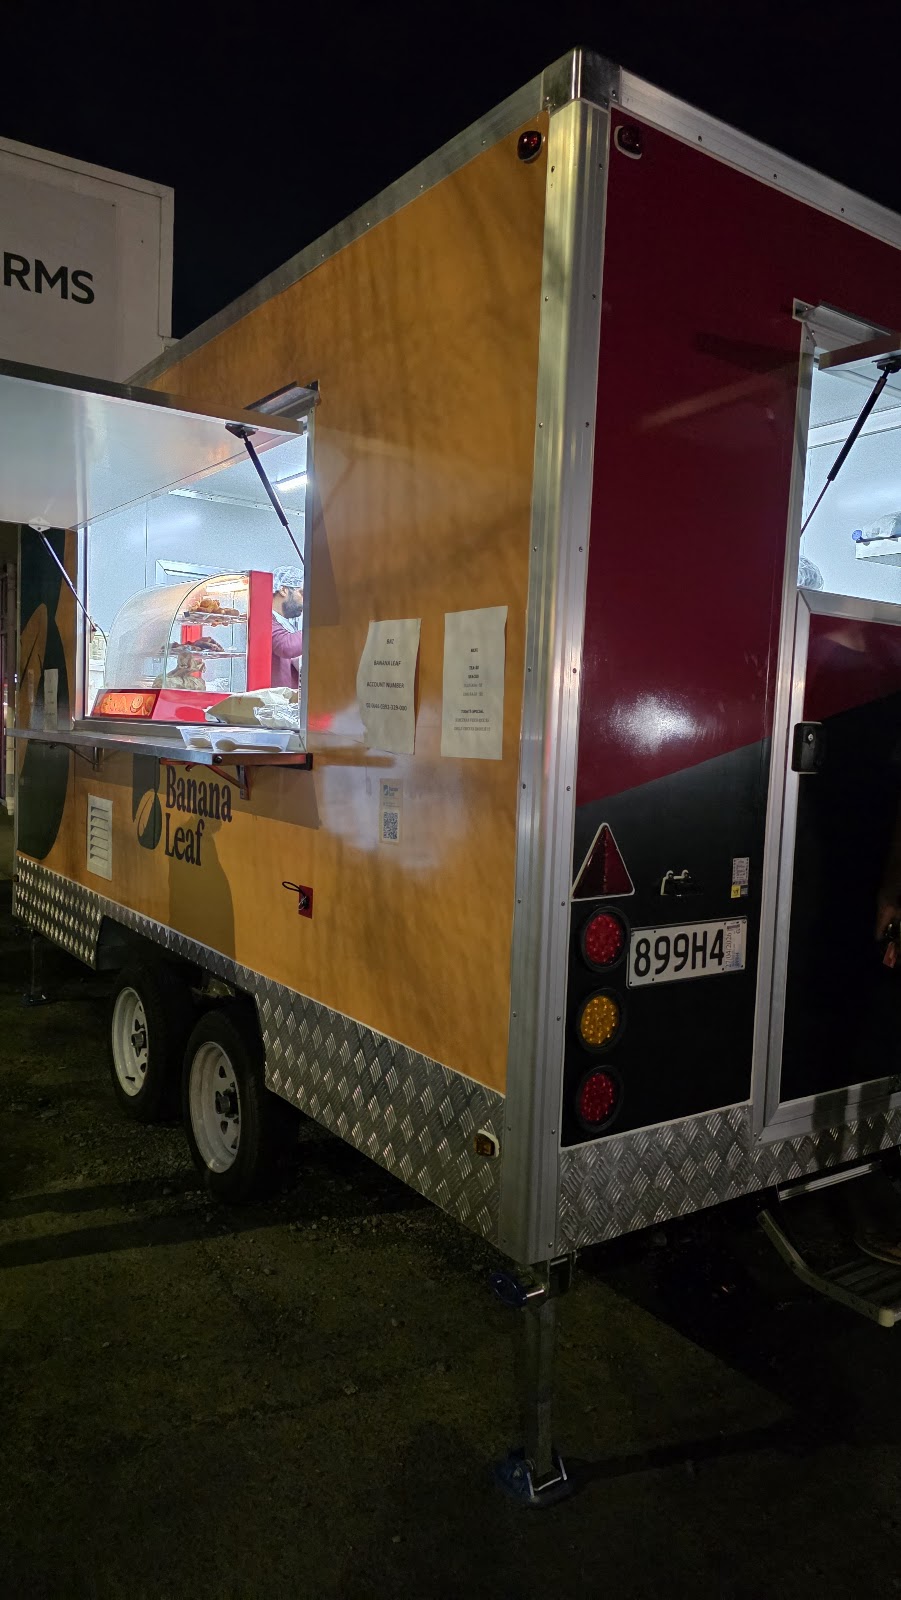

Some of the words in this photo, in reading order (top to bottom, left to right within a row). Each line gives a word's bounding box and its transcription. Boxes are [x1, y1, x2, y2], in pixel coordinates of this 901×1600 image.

[3, 251, 95, 304] RMS
[165, 765, 233, 823] Banana
[164, 813, 206, 866] Leaf
[633, 928, 724, 978] 899H4
